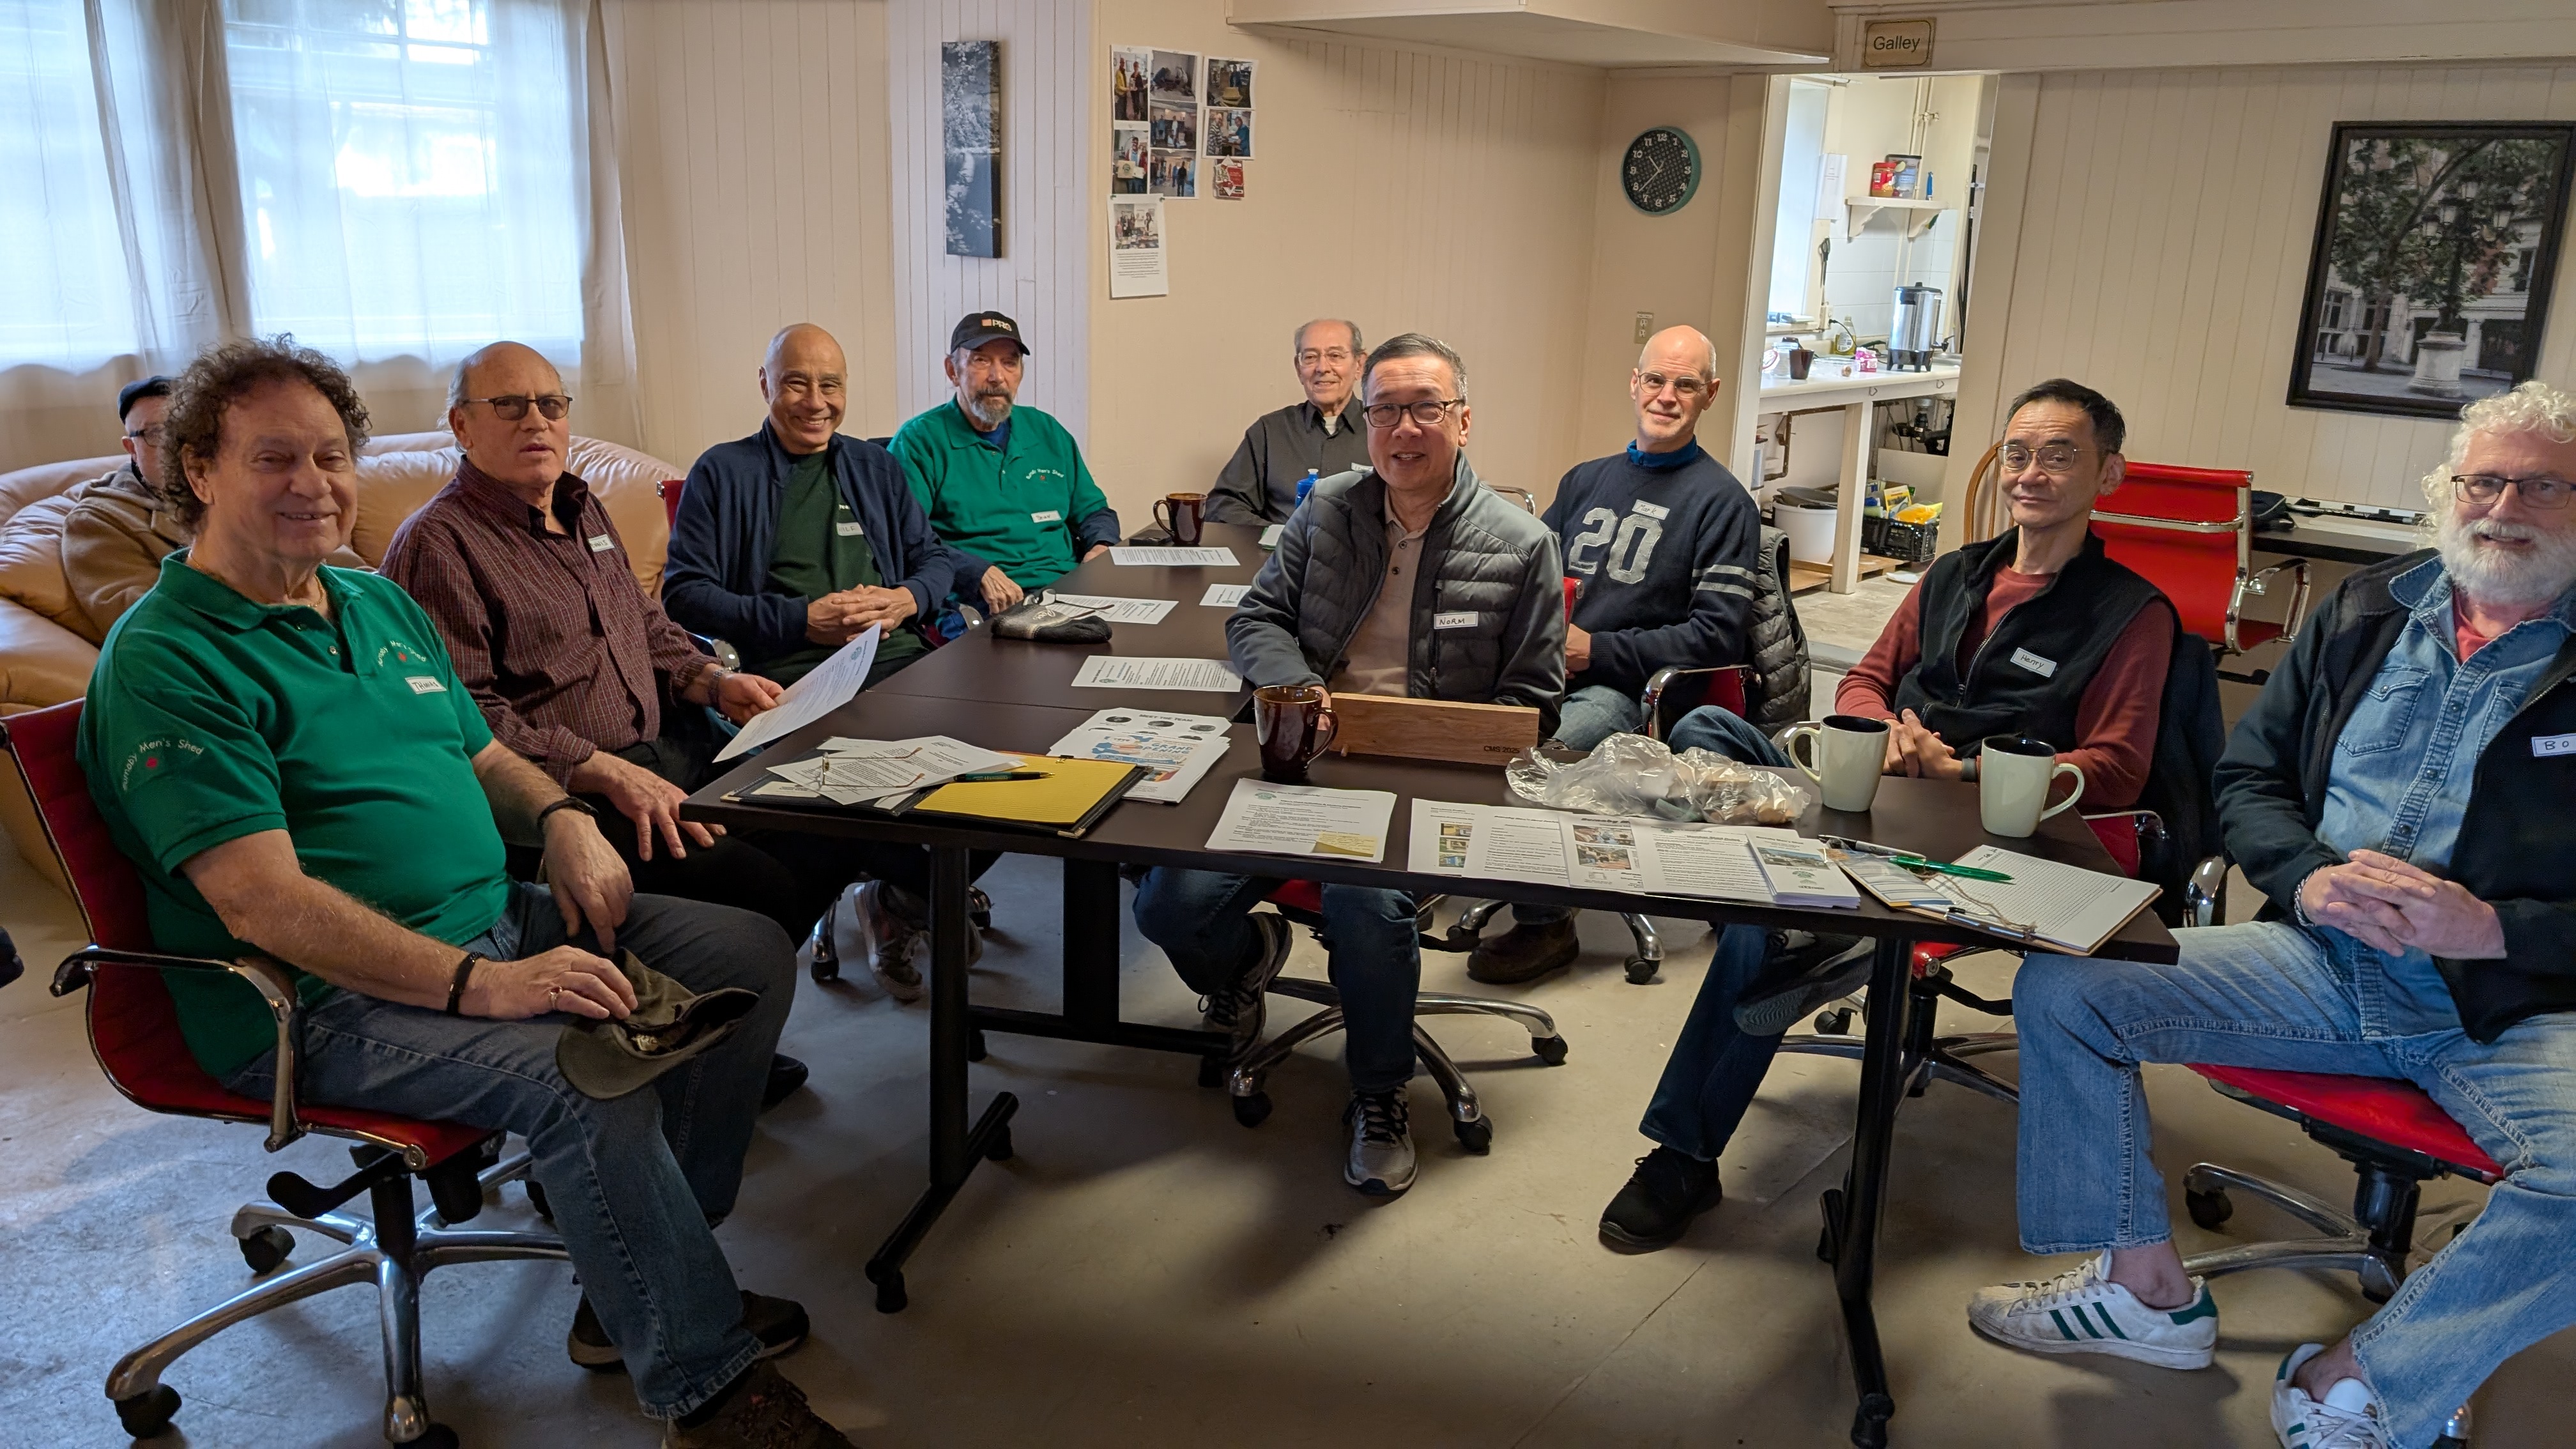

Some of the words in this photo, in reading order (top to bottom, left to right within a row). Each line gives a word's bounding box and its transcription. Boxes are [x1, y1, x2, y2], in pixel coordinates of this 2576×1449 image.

[1873, 36, 1920, 52] Galley
[1644, 138, 1652, 146] 11
[1657, 134, 1667, 142] 12
[1673, 137, 1678, 146] 1
[1633, 150, 1643, 158] 10
[1681, 150, 1689, 158] 2
[1630, 166, 1637, 174] 9
[1684, 166, 1691, 174] 3
[1632, 182, 1639, 190] 8
[1643, 194, 1649, 203] 7
[1655, 199, 1662, 207] 6
[1669, 194, 1676, 203] 5
[992, 319, 1012, 332] PRO
[1636, 504, 1657, 515] Mark
[1568, 507, 1663, 585] 20
[2021, 654, 2044, 670] Henry
[139, 738, 171, 753] Men's
[178, 739, 204, 755] Shed
[1135, 745, 1190, 754] OPENING
